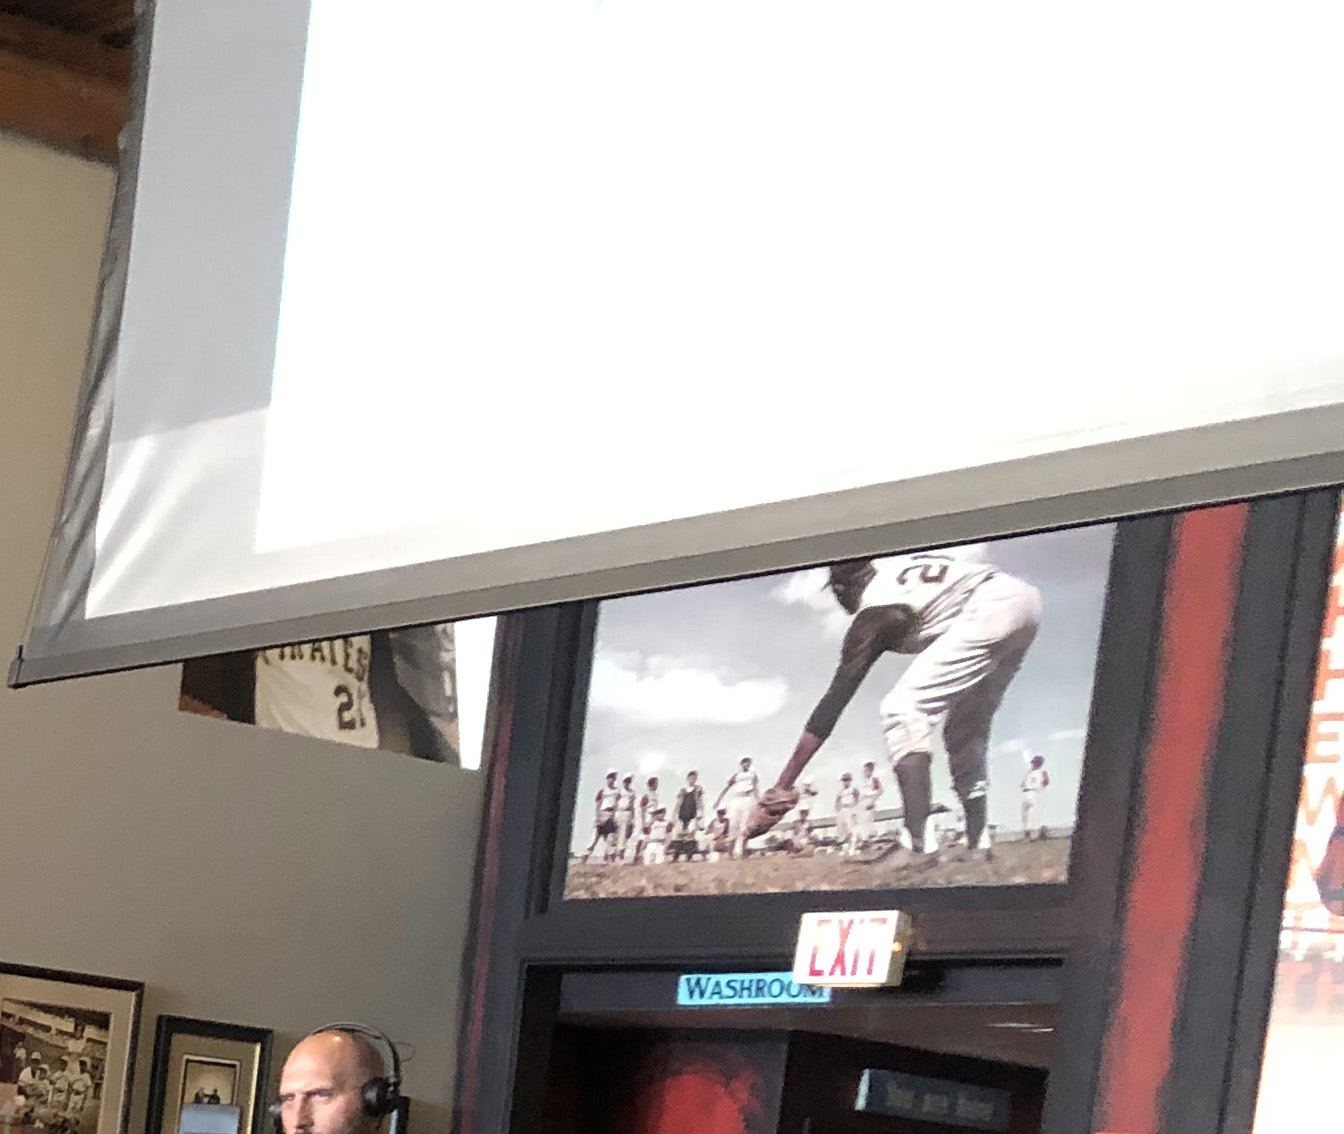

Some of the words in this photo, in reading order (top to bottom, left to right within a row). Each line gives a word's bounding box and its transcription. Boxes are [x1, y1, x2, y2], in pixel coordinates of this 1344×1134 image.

[333, 682, 367, 730] 21
[809, 917, 889, 977] EXIT
[684, 976, 826, 1001] WASHROOM
